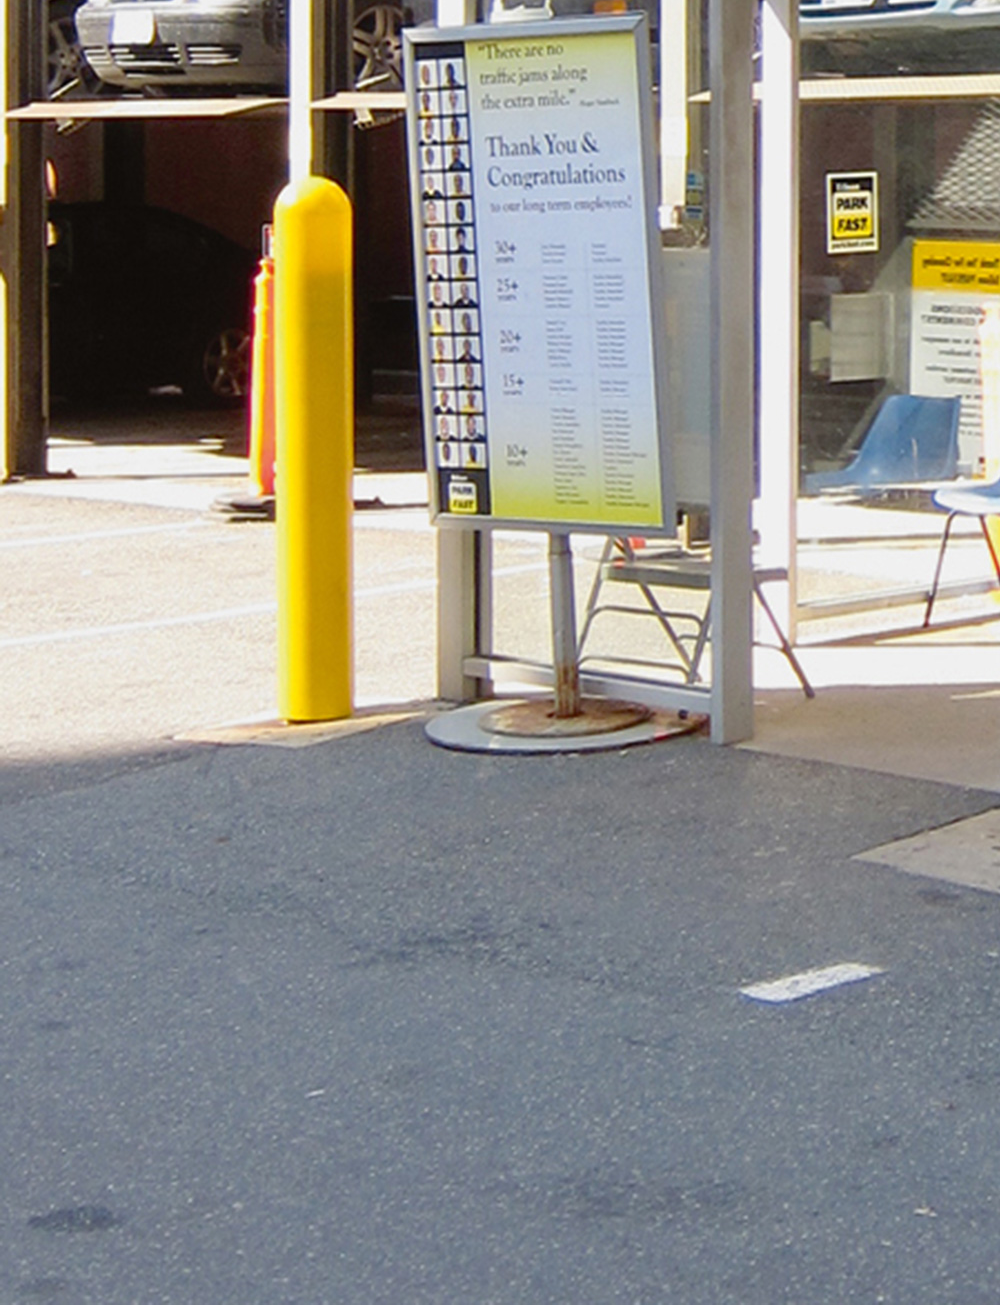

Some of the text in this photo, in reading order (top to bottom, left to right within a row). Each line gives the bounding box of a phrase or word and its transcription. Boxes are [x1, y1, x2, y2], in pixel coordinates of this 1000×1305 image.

[525, 45, 544, 58] are
[546, 42, 564, 56] no
[480, 63, 588, 87] traffic jams along
[481, 93, 501, 111] the
[503, 93, 535, 109] extra
[485, 131, 600, 158] Thank You &
[487, 162, 626, 190] Congratulations
[522, 198, 546, 214] long
[836, 196, 868, 211] PARK
[836, 217, 868, 232] FAST
